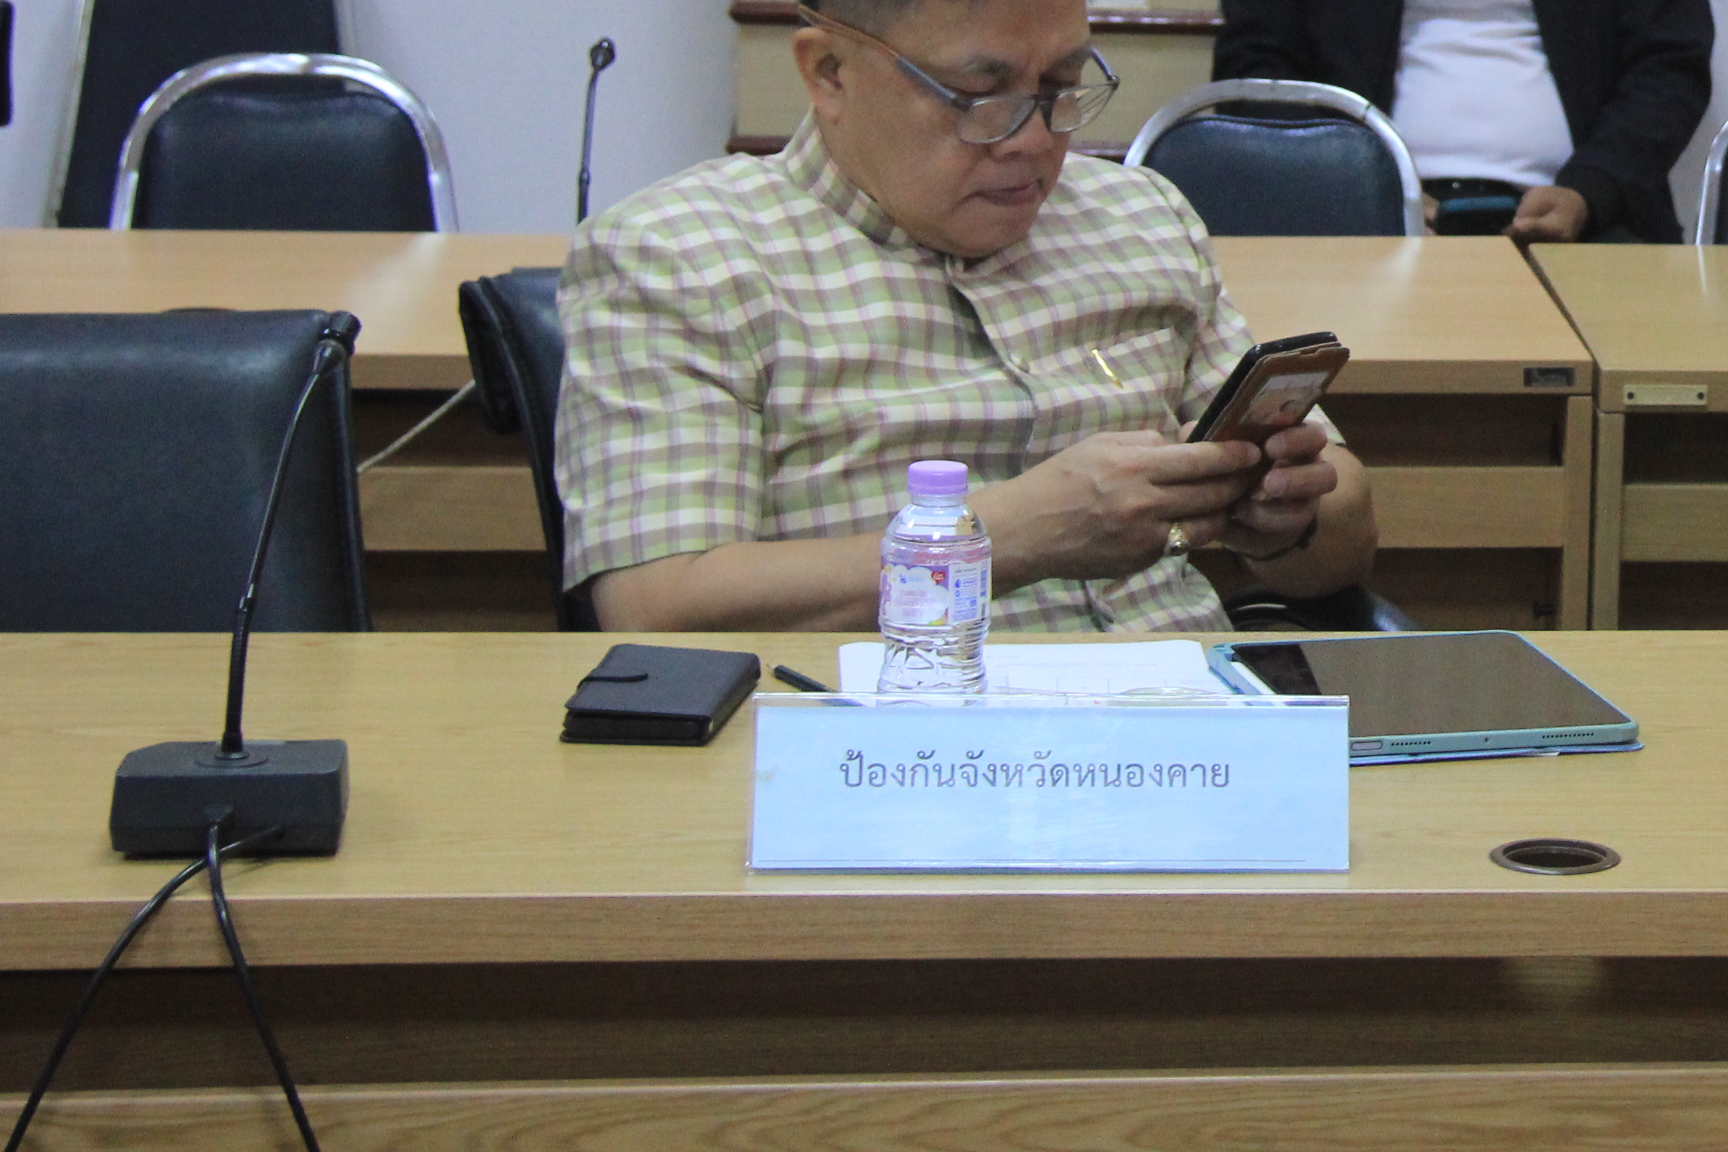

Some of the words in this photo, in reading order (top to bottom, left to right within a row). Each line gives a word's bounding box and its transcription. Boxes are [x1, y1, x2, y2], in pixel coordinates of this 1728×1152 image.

[839, 749, 1231, 788] ป้องกันจังหวัดหนองคาย
